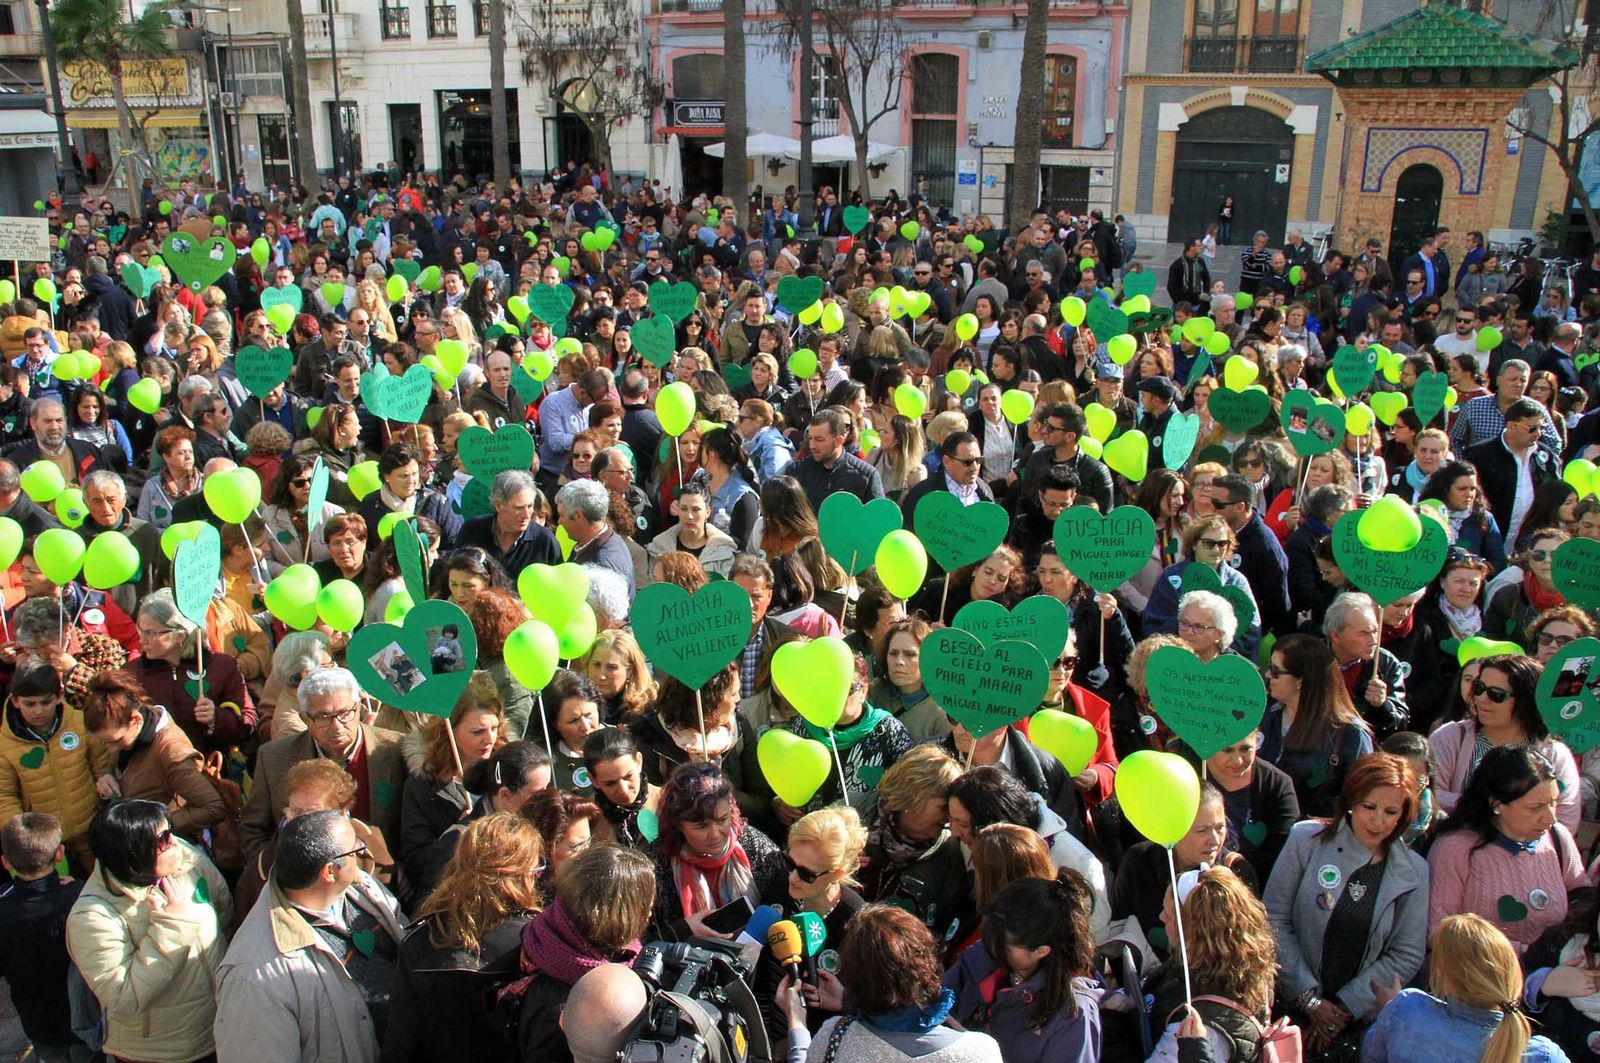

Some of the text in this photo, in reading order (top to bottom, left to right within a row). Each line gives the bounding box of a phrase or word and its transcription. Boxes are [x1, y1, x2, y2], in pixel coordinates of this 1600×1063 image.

[1064, 518, 1143, 538] JUSTICIA
[1094, 536, 1125, 547] PARA
[1114, 549, 1146, 558] ANGEL
[1089, 570, 1127, 581] MARIA
[1352, 557, 1369, 572] MI
[1376, 559, 1396, 575] SOL
[658, 591, 723, 625] MARIA
[656, 609, 741, 645] ALMONTEÑA
[672, 632, 740, 661] VALIENTE
[940, 638, 1011, 663] BESOS AL
[951, 656, 1033, 681] CIELO PARA
[1162, 667, 1179, 680] OS
[935, 667, 1023, 696] PARA MARIA
[942, 693, 1019, 718] MIGUEL ANGEL
